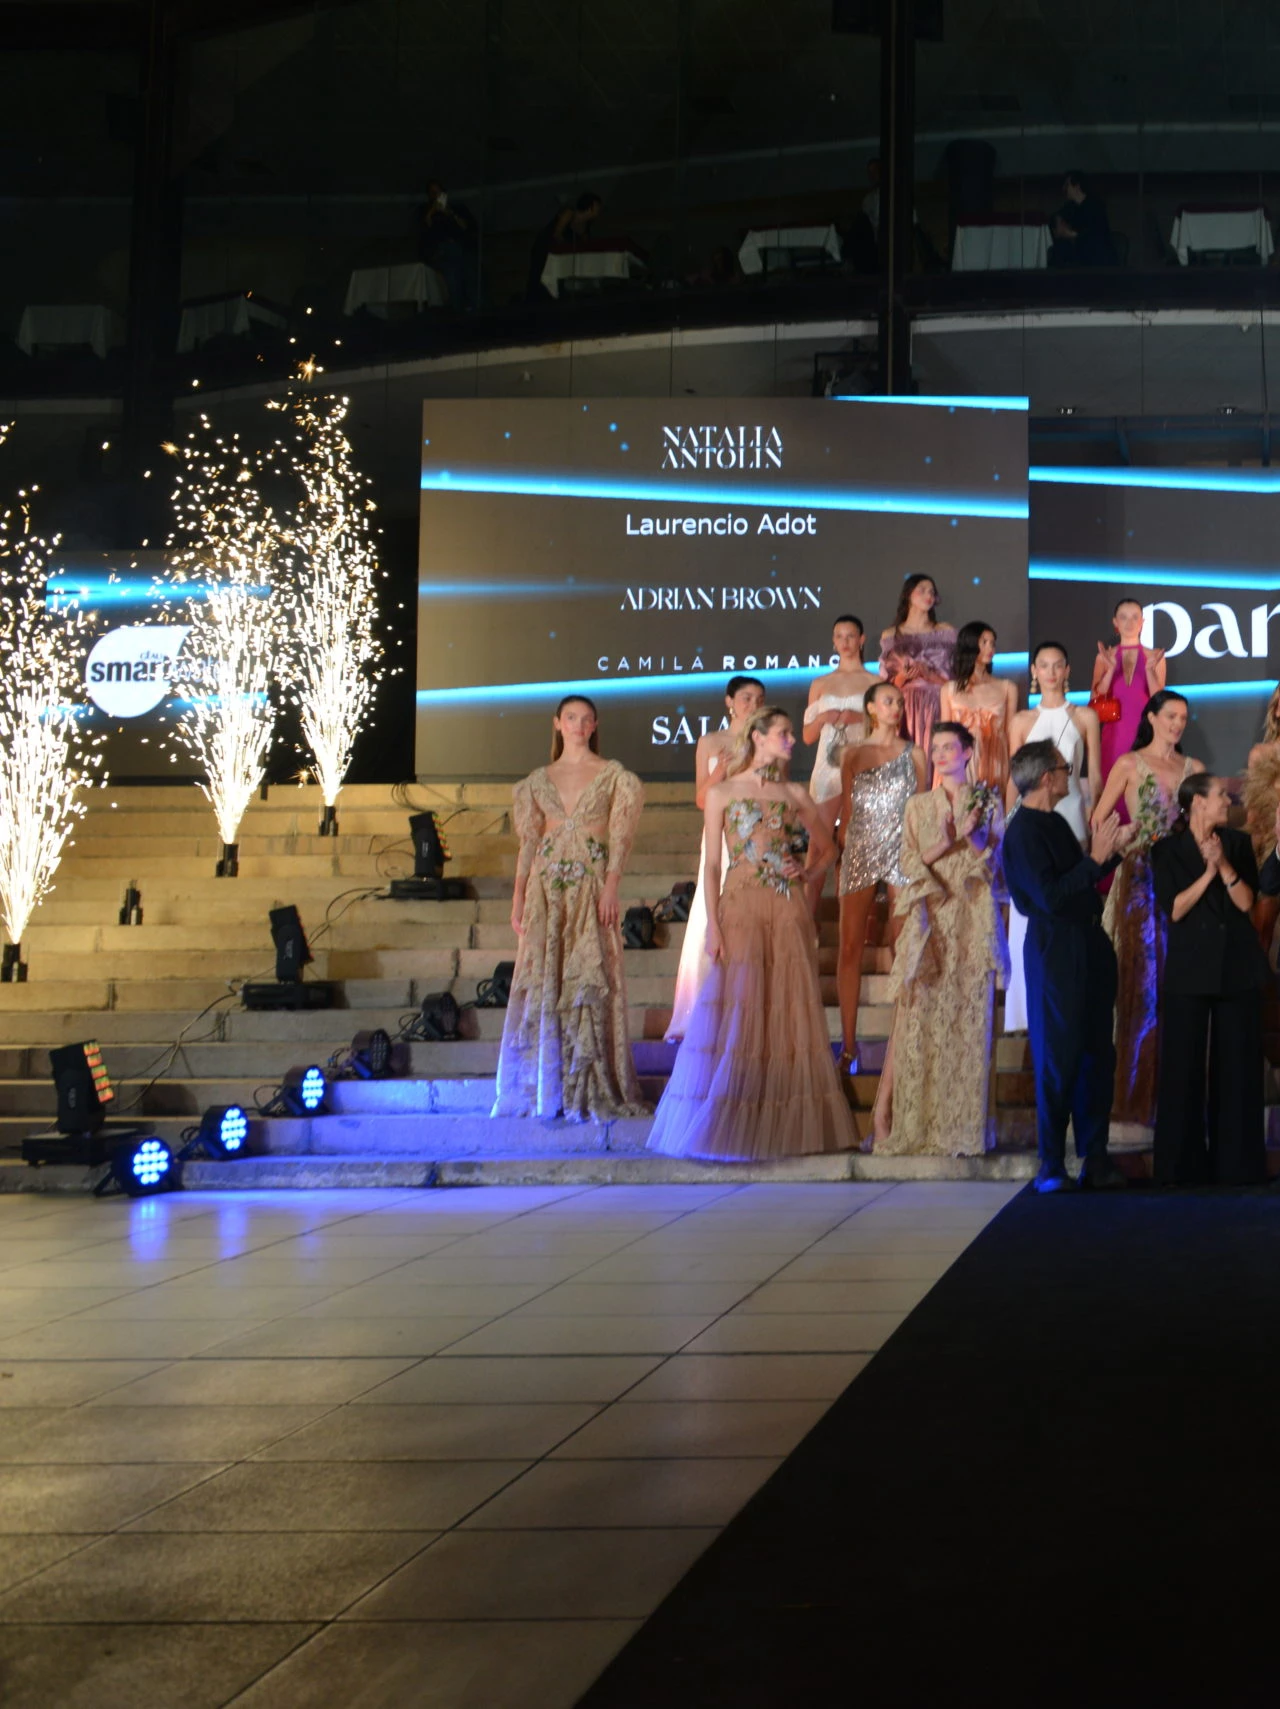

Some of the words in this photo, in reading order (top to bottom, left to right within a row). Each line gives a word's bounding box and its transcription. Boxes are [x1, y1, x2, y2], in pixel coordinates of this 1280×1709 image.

[662, 426, 783, 447] NATALIA
[661, 447, 783, 469] ANTOLIN
[626, 513, 748, 535] Laurencio
[757, 512, 817, 535] Adot
[620, 587, 715, 610] ADRIAN
[721, 586, 822, 610] BROWN
[597, 656, 704, 671] CAMILA
